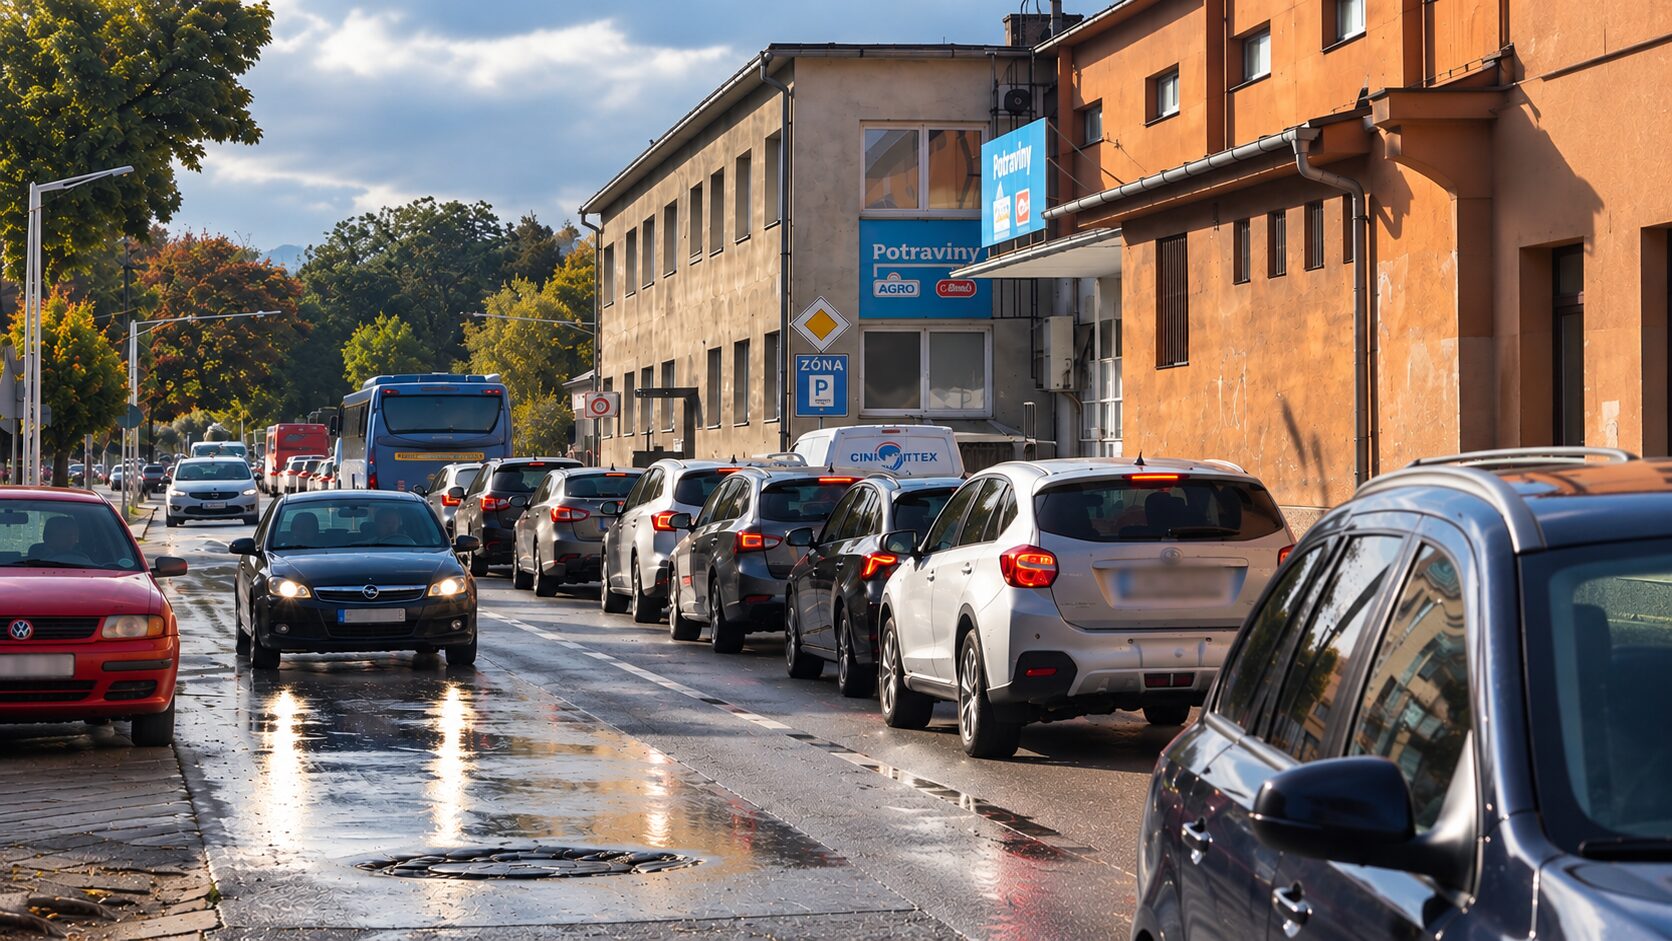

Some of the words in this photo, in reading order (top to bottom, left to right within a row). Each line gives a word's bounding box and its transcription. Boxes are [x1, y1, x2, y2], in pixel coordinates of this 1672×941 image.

[993, 141, 1032, 181] Potraviny
[873, 242, 980, 264] Potraviny
[878, 284, 915, 294] AGRO
[800, 356, 844, 371] ZÓNA
[815, 379, 829, 396] P
